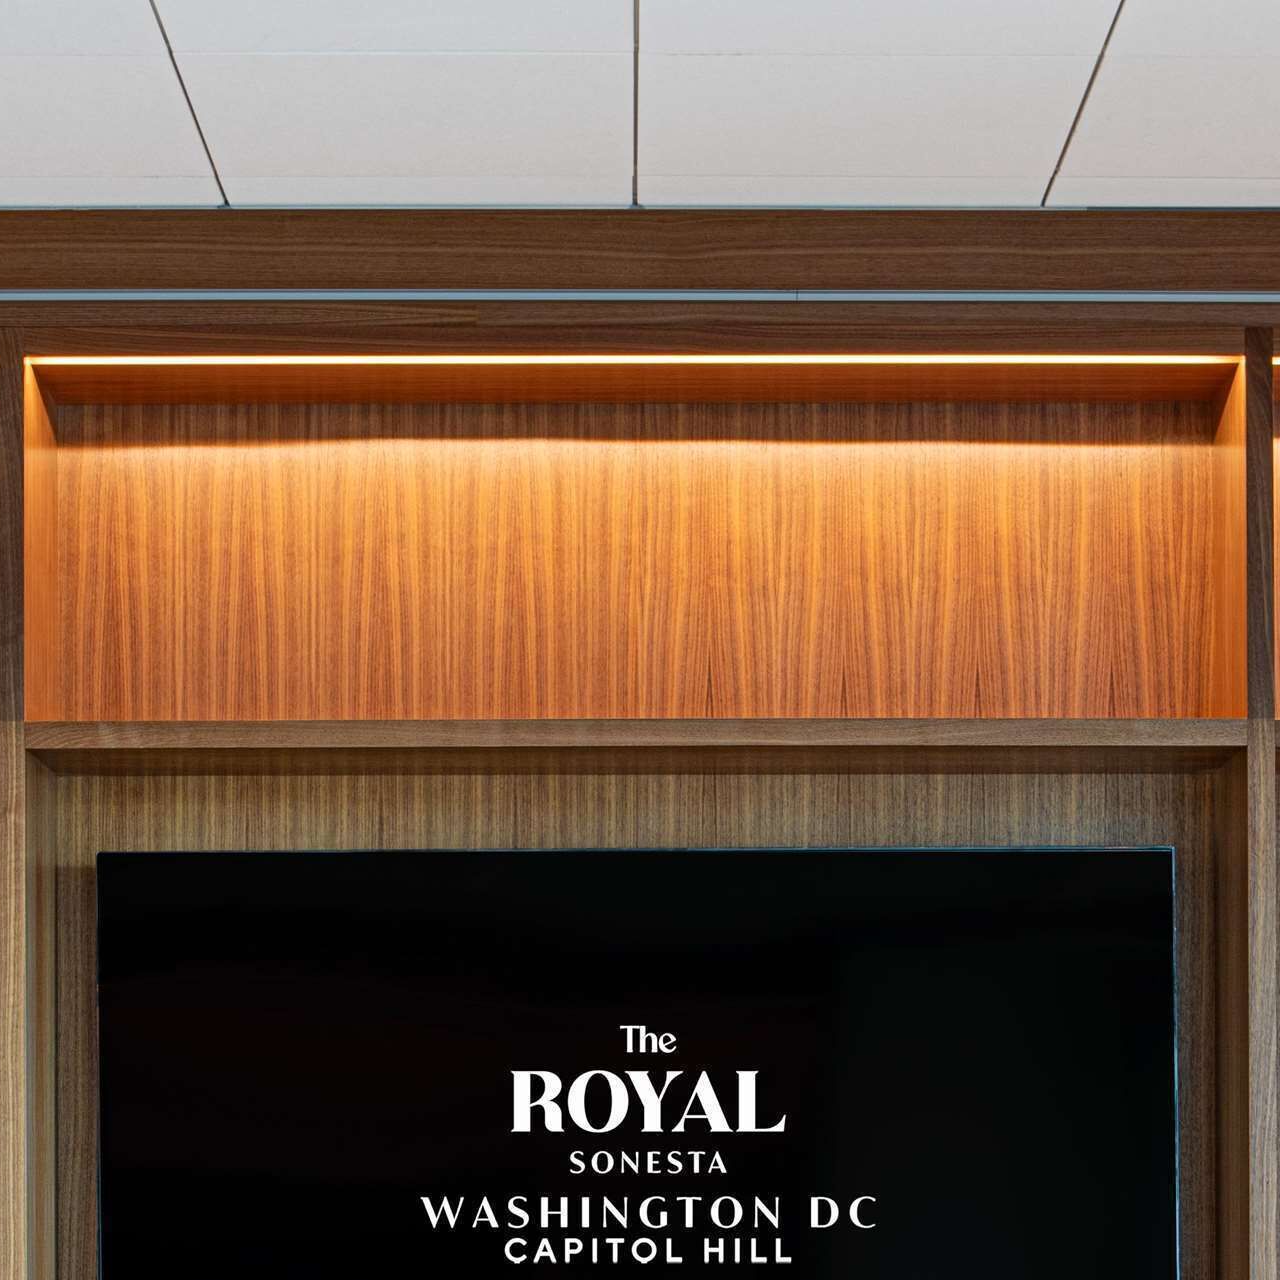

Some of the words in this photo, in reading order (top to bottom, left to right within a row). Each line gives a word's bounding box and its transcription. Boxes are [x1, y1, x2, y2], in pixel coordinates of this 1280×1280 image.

[619, 1025, 677, 1053] The
[510, 1070, 786, 1133] ROYAL
[569, 1150, 728, 1174] SONESTA
[420, 1195, 781, 1229] WASHINGTON
[810, 1195, 878, 1229] DC
[504, 1237, 683, 1265] CAPITOL
[703, 1237, 792, 1264] HILL
